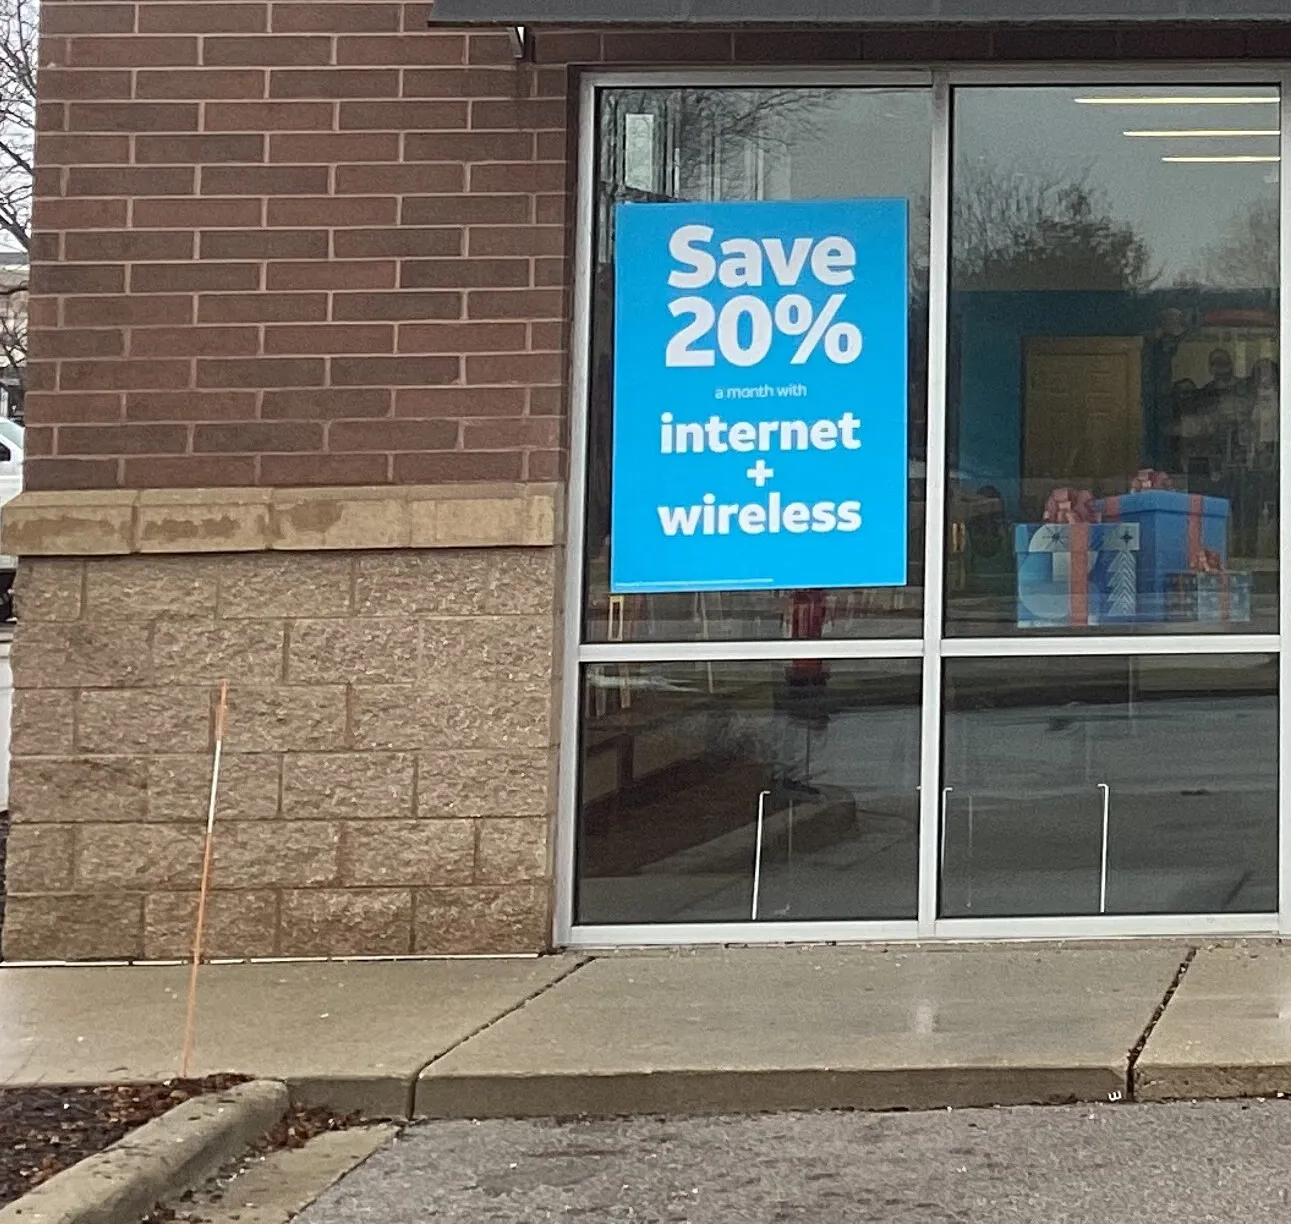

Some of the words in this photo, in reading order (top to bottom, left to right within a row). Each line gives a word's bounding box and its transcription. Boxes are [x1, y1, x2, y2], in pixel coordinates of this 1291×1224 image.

[667, 224, 856, 289] Save
[665, 293, 863, 367] 20%
[715, 389, 723, 399] a
[726, 384, 774, 399] month
[777, 382, 807, 397] with
[661, 412, 862, 453] internet
[746, 459, 774, 487] +
[657, 492, 862, 536] wireless
